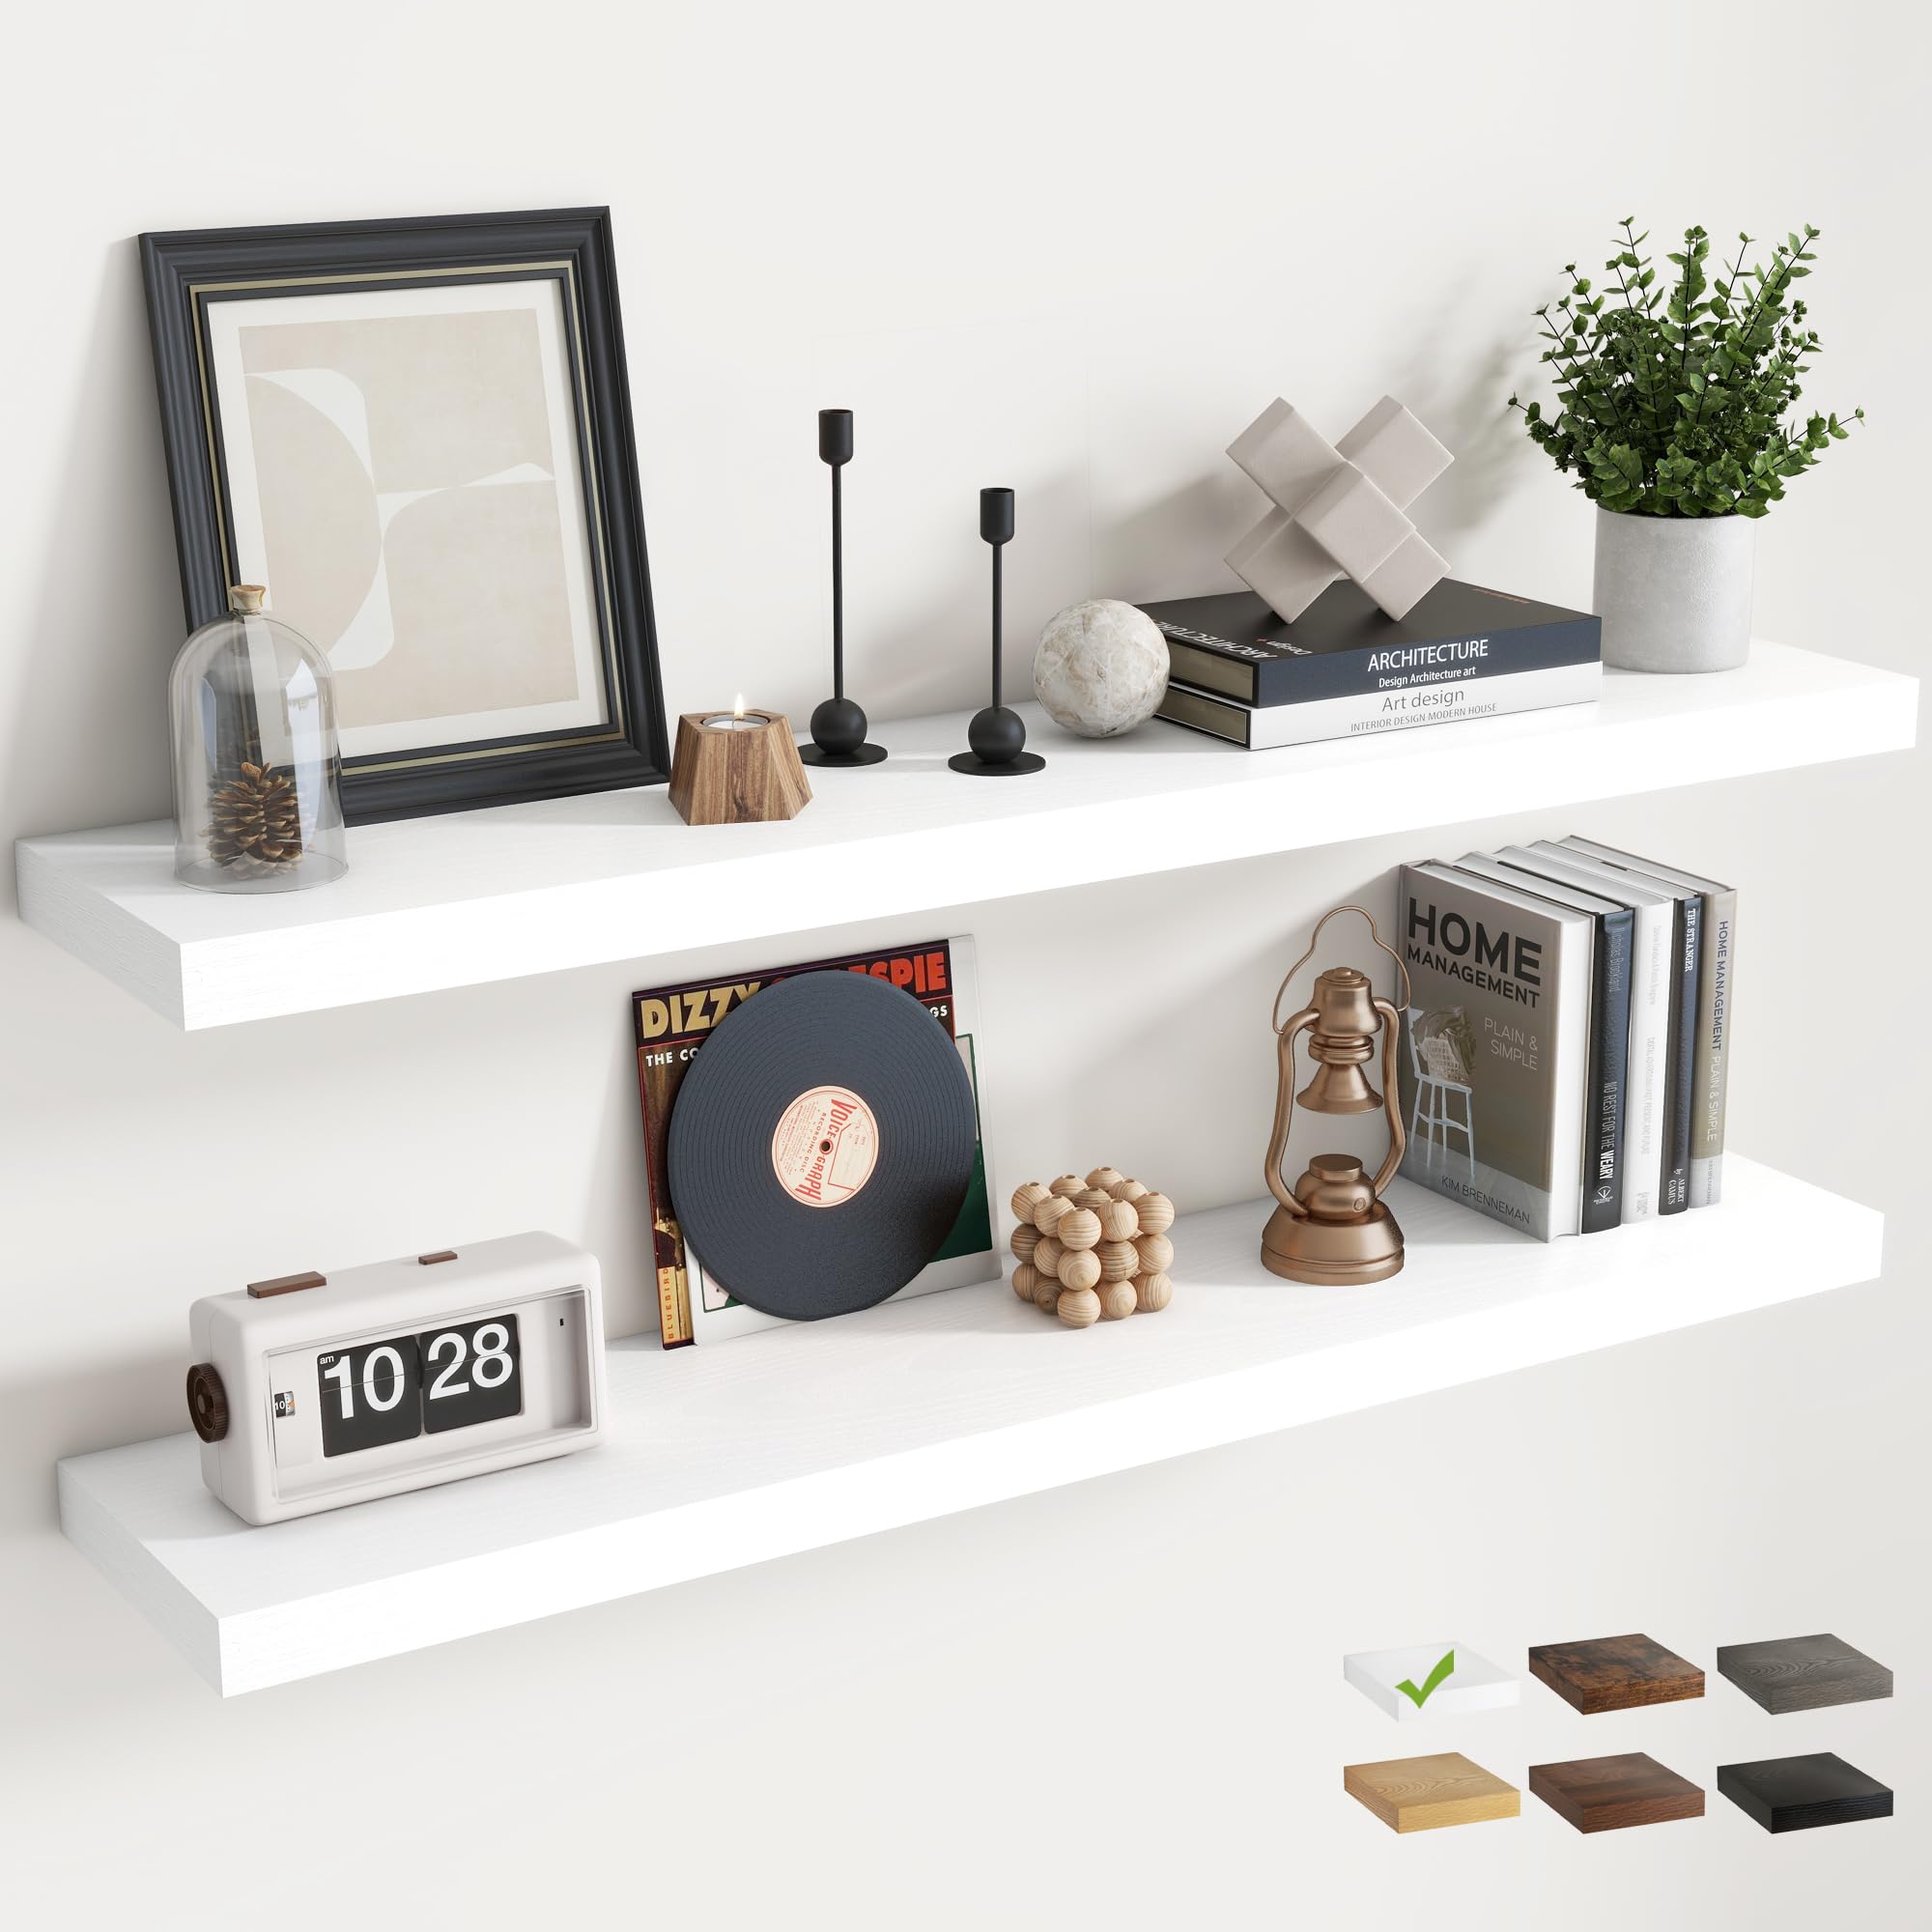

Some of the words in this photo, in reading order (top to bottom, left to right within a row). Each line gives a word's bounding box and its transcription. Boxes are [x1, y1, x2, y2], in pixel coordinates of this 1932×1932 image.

[1368, 639, 1489, 671] ARCHITECTURE
[1378, 675, 1407, 688] Design
[1409, 668, 1462, 683] Architecture
[1463, 667, 1476, 676] art
[1381, 696, 1406, 712] Art
[1411, 690, 1464, 708] design
[1350, 719, 1392, 732] INTERIOR
[1393, 714, 1426, 725] DESIGN
[1428, 708, 1466, 721] MODERN
[1468, 703, 1497, 715] HOUSE
[1687, 908, 1696, 926] THE
[1408, 896, 1542, 986] HOME
[1685, 927, 1696, 973] STRANGER
[1717, 921, 1729, 958] HOME
[1407, 943, 1541, 1009] MANAGEMENT
[1712, 960, 1727, 1050] MANAGEMENT
[1484, 1017, 1524, 1045] PLAIN
[1528, 1036, 1539, 1051] &
[645, 1051, 673, 1067] THE
[1491, 1039, 1538, 1070] SIMPLE
[1604, 1081, 1617, 1094] NO
[1710, 1056, 1721, 1089] PLAIN
[1603, 1094, 1617, 1114] REST
[808, 1112, 827, 1154] RECORDING
[1602, 1115, 1616, 1131] FOR
[1707, 1101, 1719, 1142] SIMPLE
[1601, 1132, 1615, 1150] THE
[800, 1156, 810, 1173] DISC
[1600, 1150, 1614, 1179] WEARY
[1441, 1175, 1460, 1191] KIM
[1462, 1184, 1530, 1224] BRENNEMAN
[1667, 1179, 1677, 1206] CAMUS
[663, 1267, 674, 1340] BLUEBIRD
[319, 1354, 334, 1365] am
[324, 1346, 405, 1419] 10
[427, 1322, 514, 1401] 28
